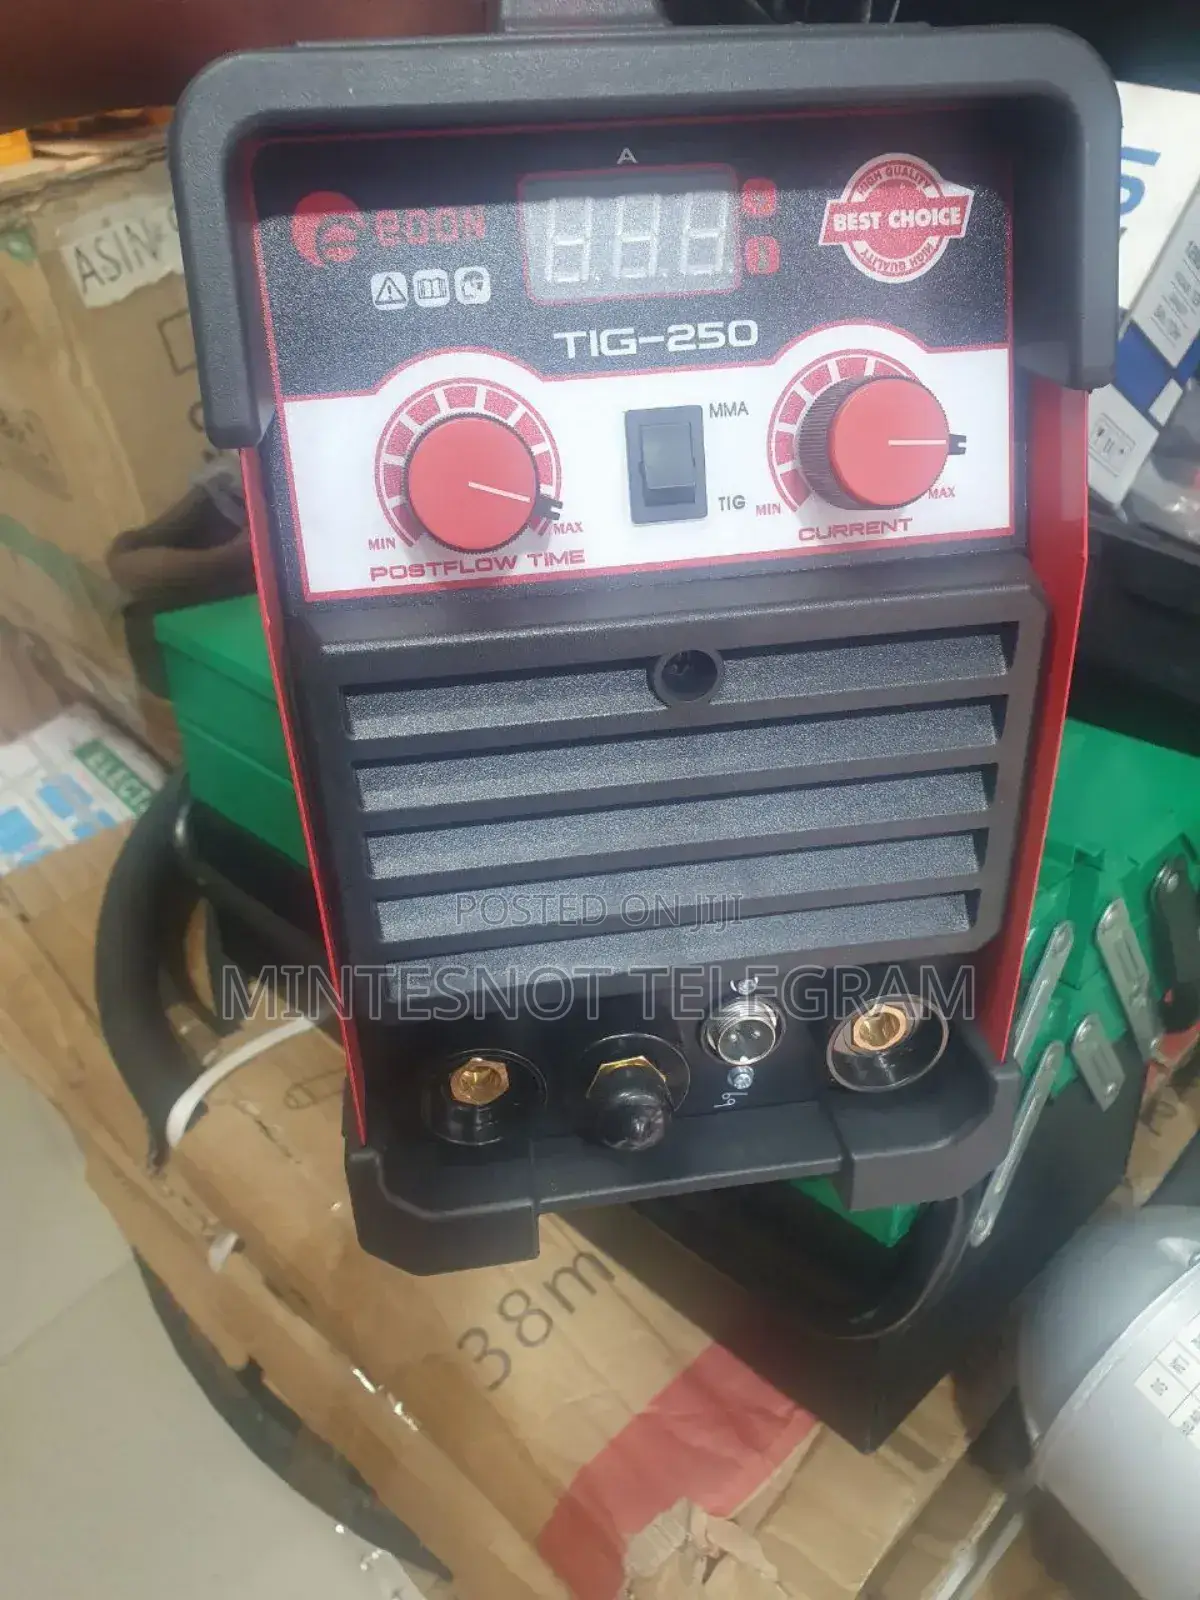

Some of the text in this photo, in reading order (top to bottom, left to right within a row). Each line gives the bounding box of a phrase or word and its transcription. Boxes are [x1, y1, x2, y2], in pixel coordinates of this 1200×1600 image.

[616, 147, 639, 165] A
[856, 165, 932, 196] HIGH QUALITY
[832, 205, 962, 232] BEST CHOICE
[553, 318, 759, 360] TIG-250
[708, 401, 750, 419] MMA
[928, 486, 956, 500] MAX
[718, 494, 746, 512] TIG
[755, 502, 782, 517] MIN
[552, 520, 585, 535] MAX
[798, 517, 914, 542] CURRENT
[367, 536, 396, 552] MIN
[369, 548, 586, 582] POSTFLOW TIME
